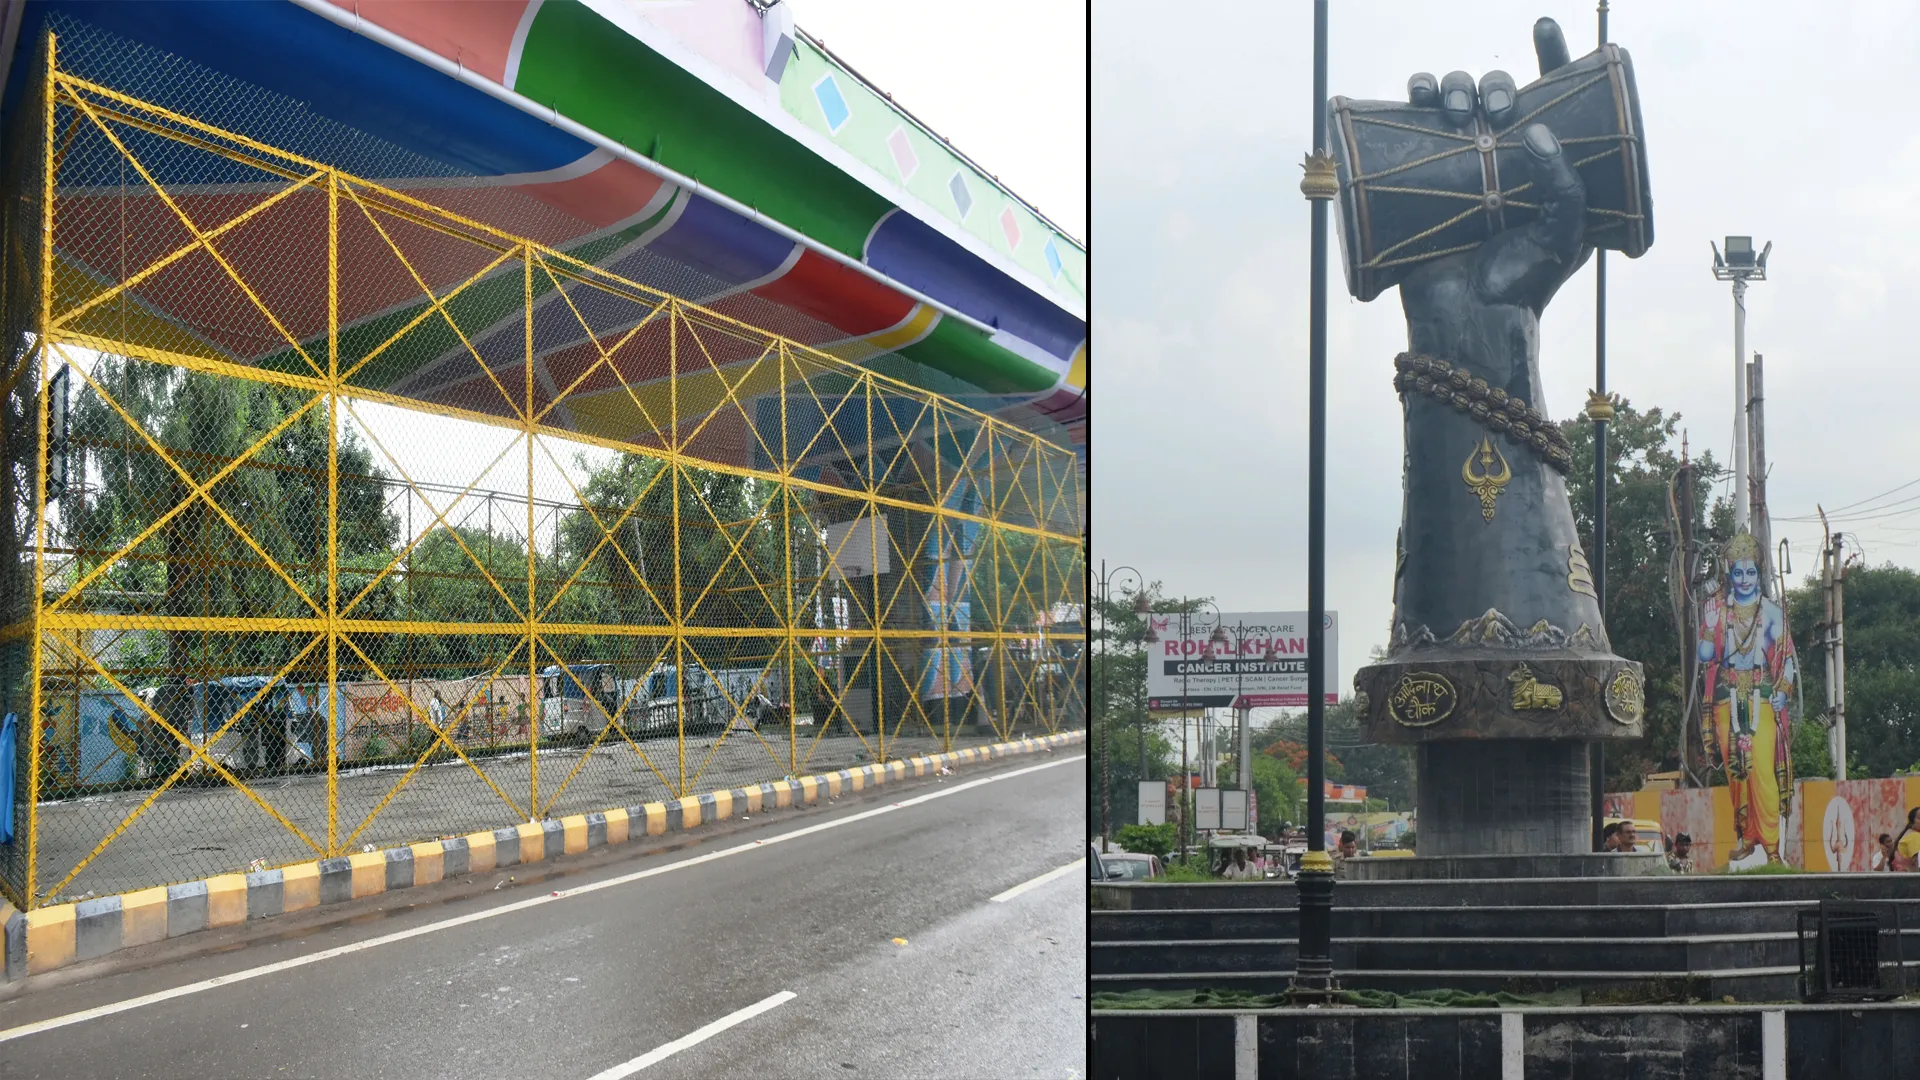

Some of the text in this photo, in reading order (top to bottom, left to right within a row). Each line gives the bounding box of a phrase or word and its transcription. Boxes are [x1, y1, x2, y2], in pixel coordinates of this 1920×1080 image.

[1230, 625, 1268, 633] CANCER
[1270, 625, 1295, 633] CARE
[1177, 661, 1305, 673] CANCER INSTITUTE
[1394, 676, 1449, 708] आदिनाथ
[1405, 696, 1436, 719] चौक
